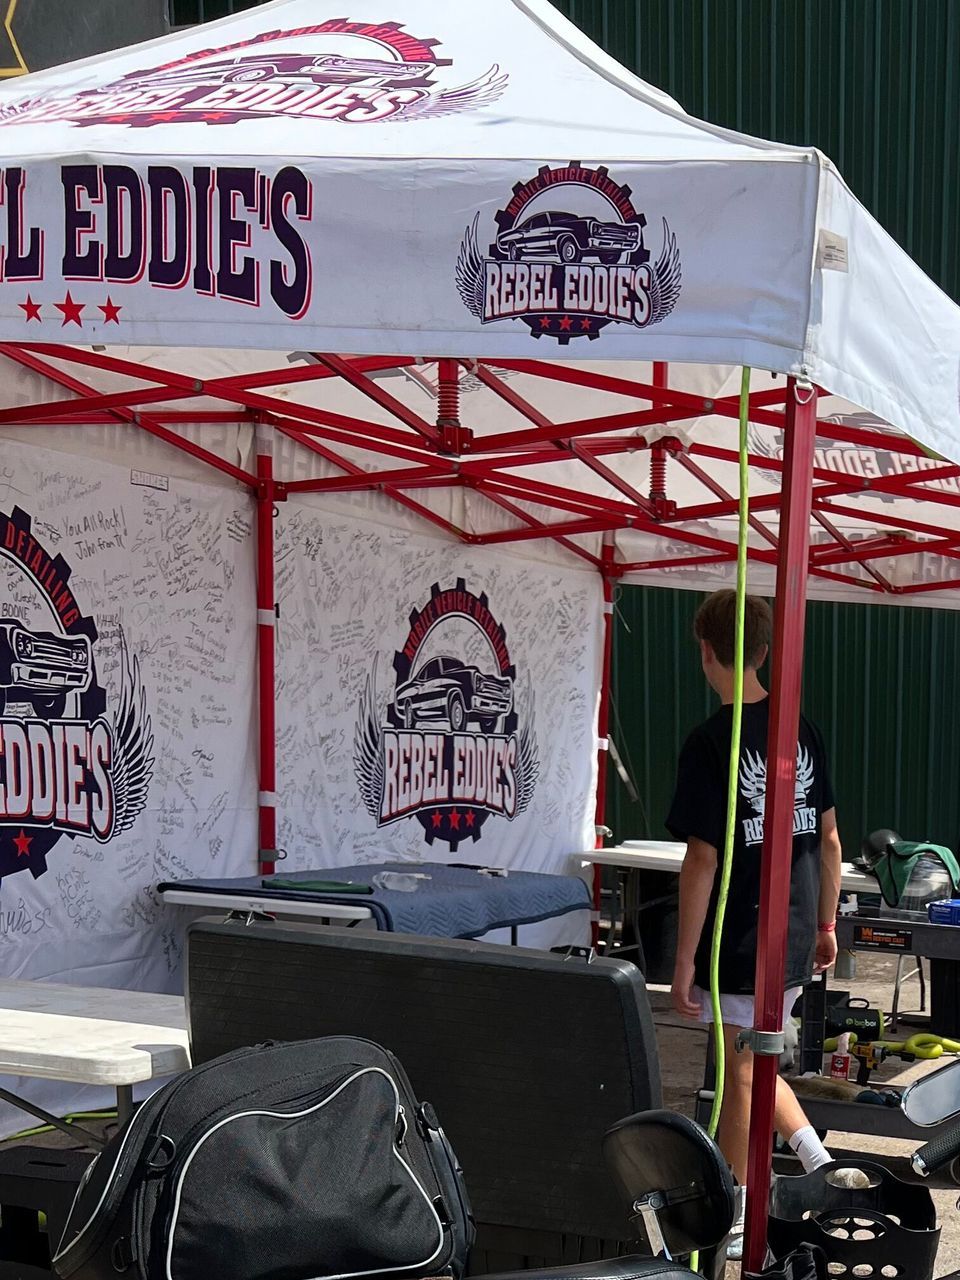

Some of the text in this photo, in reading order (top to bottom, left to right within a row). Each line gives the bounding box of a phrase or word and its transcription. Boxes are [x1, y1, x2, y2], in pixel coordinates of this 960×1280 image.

[507, 168, 634, 220] MOBILE VEHICLE DETAILING
[61, 165, 313, 321] EDDIE'S
[484, 261, 651, 325] REBEL EDDIE'S
[4, 521, 81, 628] DETAILING
[404, 590, 511, 674] MOBILE VEHICLE DETAILING
[382, 731, 449, 820] REBEL
[453, 733, 518, 820] EDDIE'S
